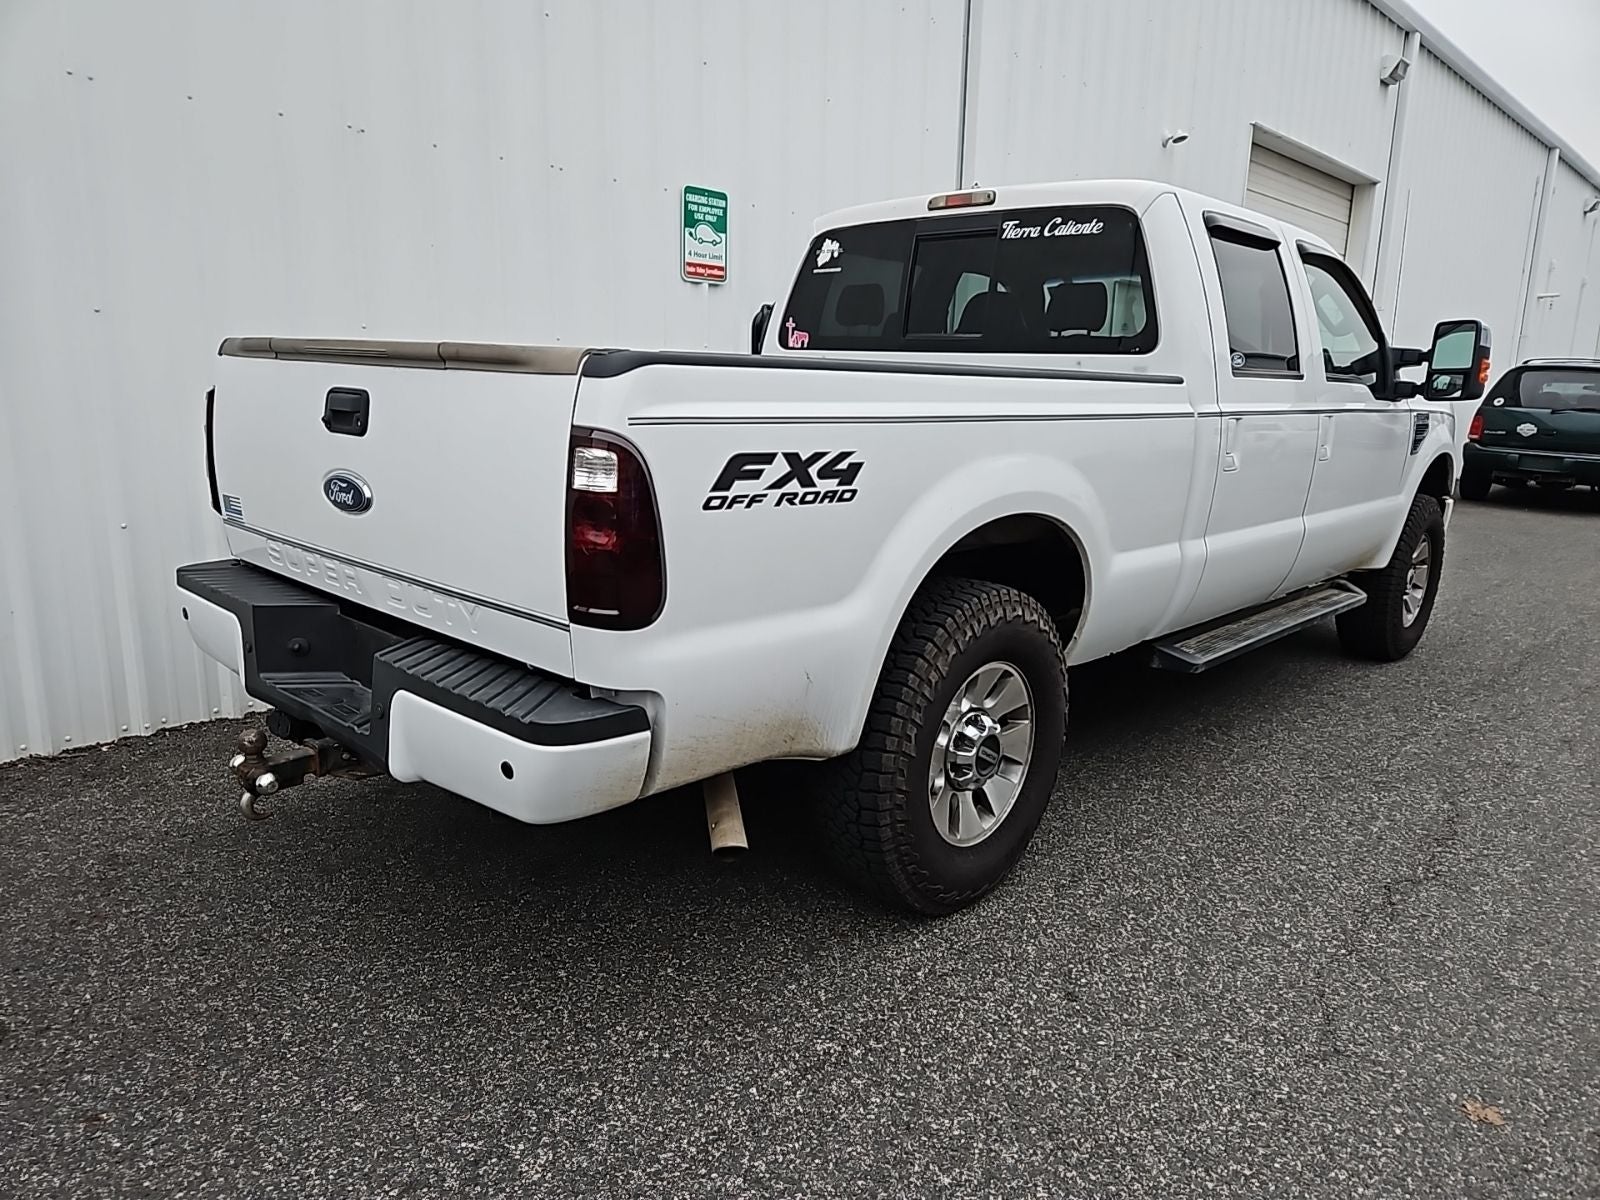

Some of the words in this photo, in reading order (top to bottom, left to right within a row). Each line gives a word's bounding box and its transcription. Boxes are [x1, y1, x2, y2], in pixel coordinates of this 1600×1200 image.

[686, 193, 708, 204] CHARGING
[688, 203, 698, 211] FOR
[699, 205, 723, 216] EMPLOYEE
[694, 212, 704, 220] USE
[705, 214, 717, 222] ONLY
[1001, 220, 1041, 239] Tierra
[1043, 216, 1104, 237] Caliente
[693, 250, 708, 259] Hour
[709, 252, 723, 260] Limit
[709, 451, 865, 492] FX4
[328, 479, 354, 505] Ford
[702, 493, 768, 511] OFF
[773, 489, 858, 507] ROAD
[266, 540, 362, 595] SUPER
[386, 578, 484, 635] DUTY
